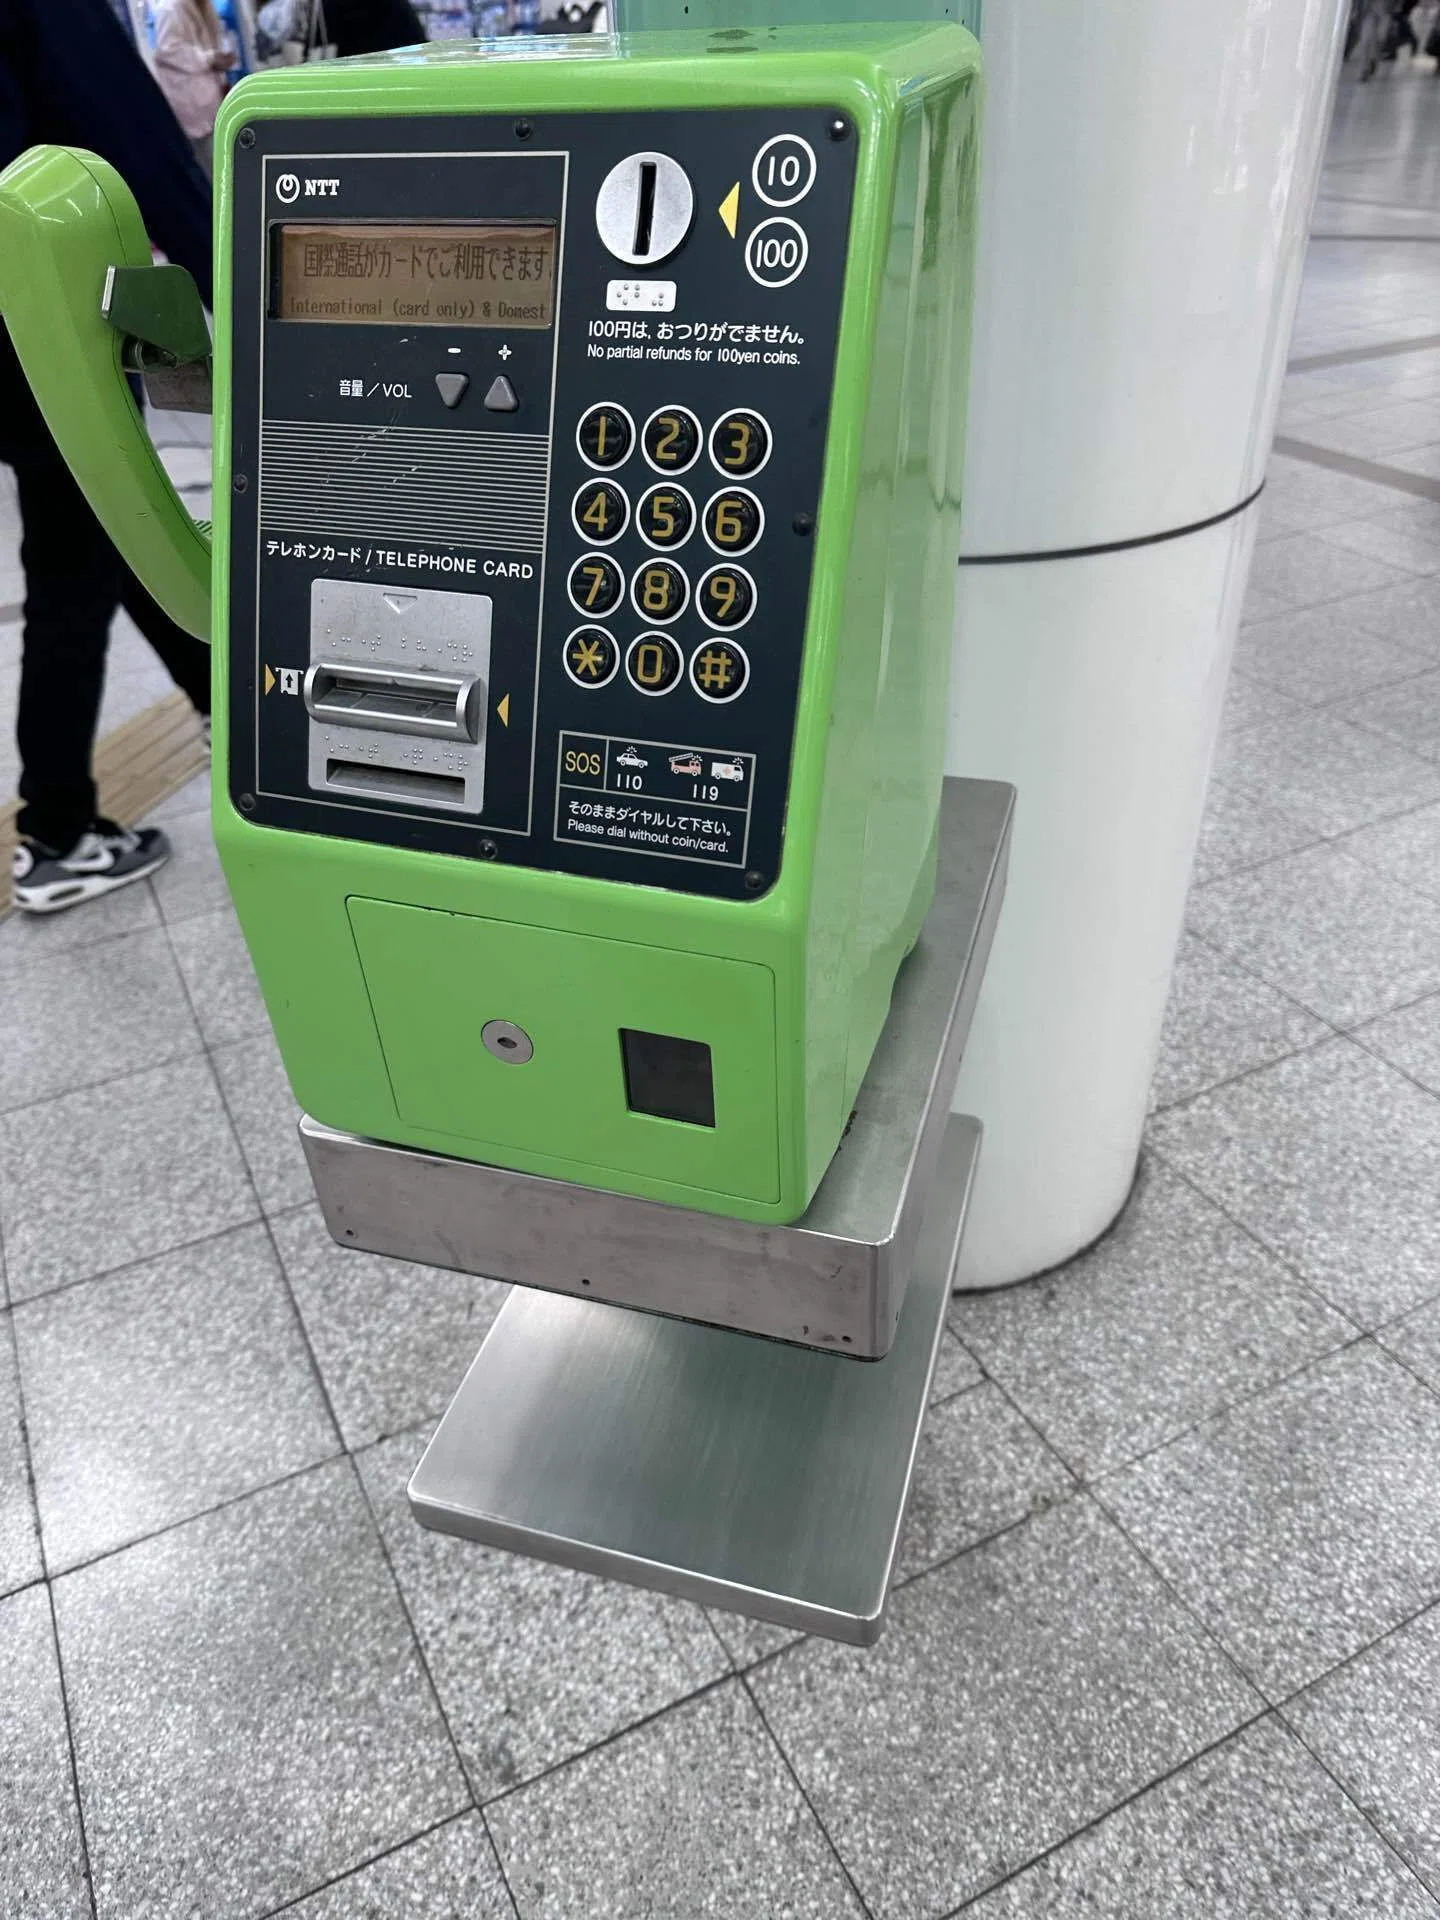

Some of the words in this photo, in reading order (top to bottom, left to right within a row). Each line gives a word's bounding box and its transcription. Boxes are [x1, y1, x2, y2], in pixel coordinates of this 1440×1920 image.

[768, 156, 800, 187] 10
[304, 179, 340, 196] NTT
[756, 239, 799, 268] 100
[290, 297, 382, 315] International
[393, 298, 430, 317] (card
[436, 299, 475, 319] only)
[482, 301, 492, 318] &
[587, 344, 605, 358] No
[606, 345, 643, 360] partial
[646, 346, 692, 361] refunds
[695, 347, 713, 361] for
[717, 348, 760, 365] 100yen
[763, 350, 800, 365] coins.
[655, 417, 680, 461] 2
[724, 422, 750, 465] 3
[583, 491, 608, 532] 4
[652, 496, 675, 537] 5
[715, 501, 742, 543] 6
[376, 550, 477, 574] TELEPHONE
[482, 560, 534, 580] CARD
[582, 567, 605, 607] 7
[643, 570, 670, 611] 8
[710, 576, 738, 618] 9
[637, 644, 663, 684] 0
[565, 751, 601, 775] SOS
[616, 773, 643, 791] 110
[692, 783, 719, 801] 119
[568, 801, 731, 836] そのままダイヤルして下さい。
[567, 818, 605, 835] Please
[606, 825, 627, 838] dial
[628, 828, 670, 844] without
[671, 835, 729, 853] coin/card.
